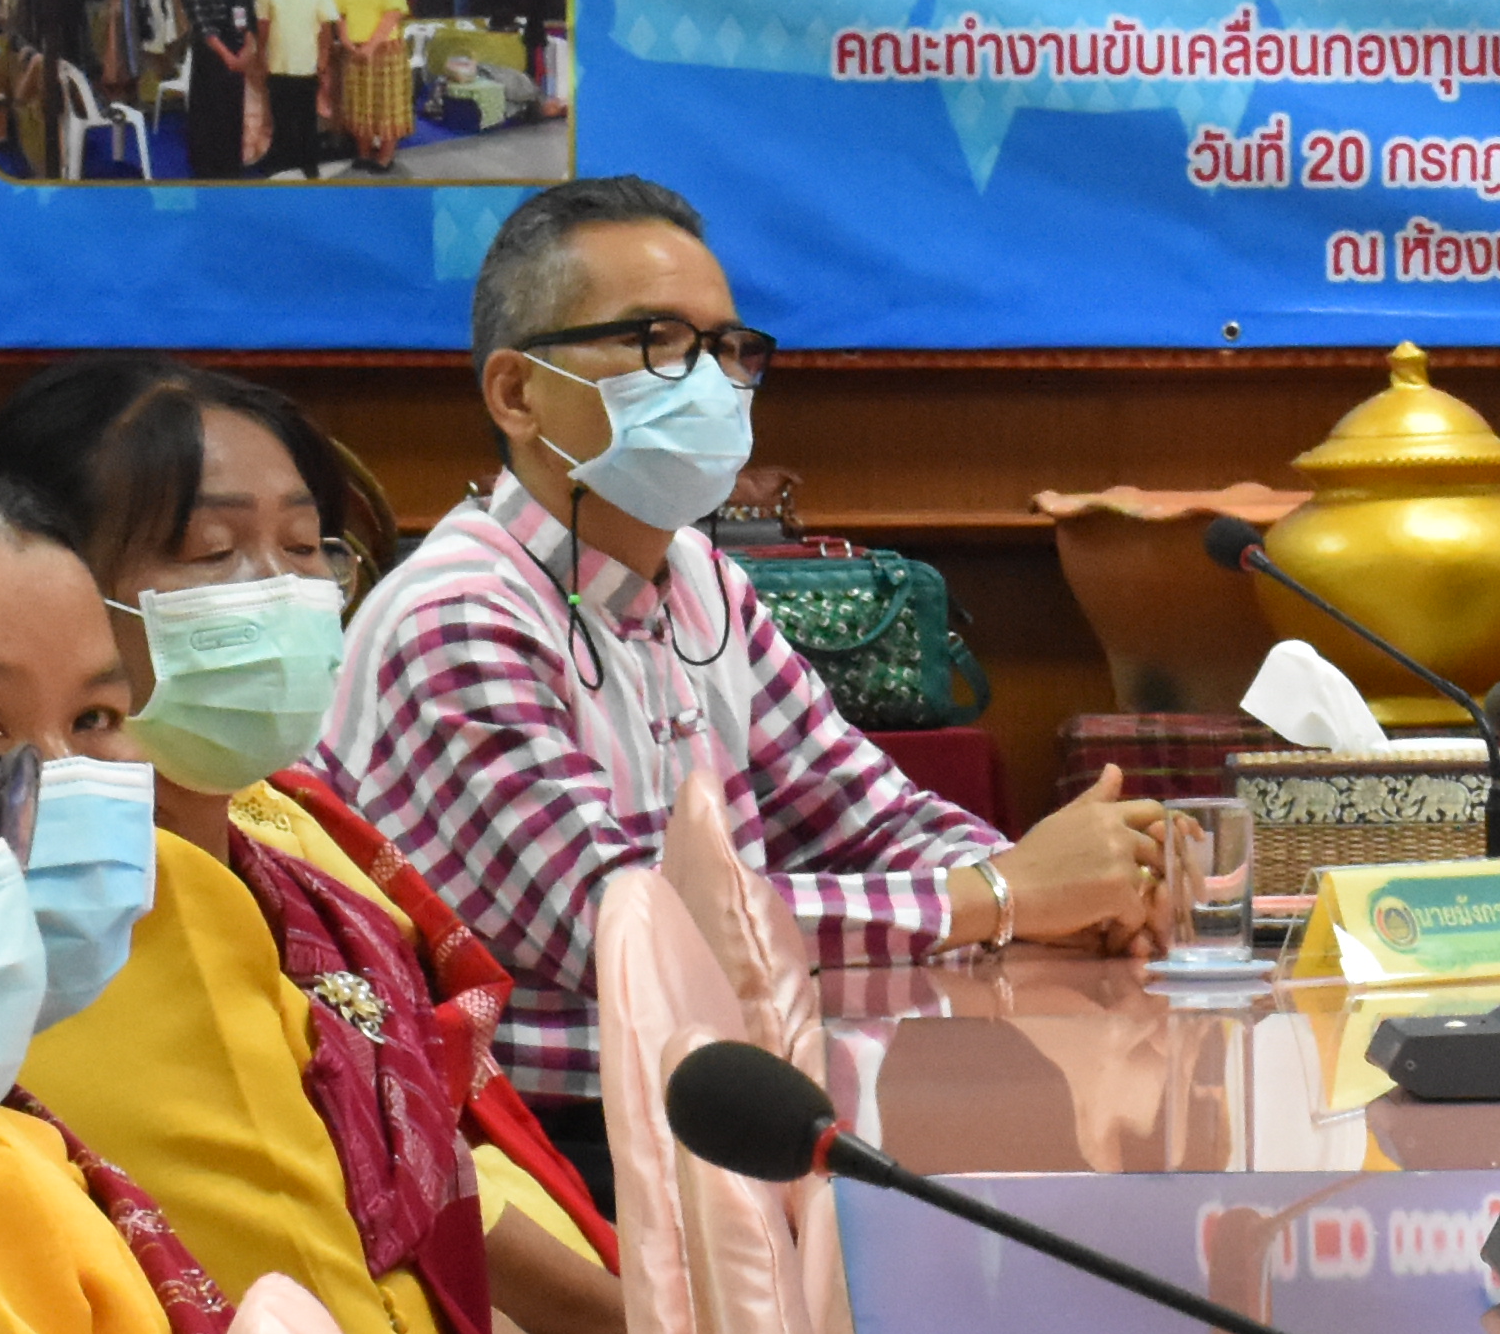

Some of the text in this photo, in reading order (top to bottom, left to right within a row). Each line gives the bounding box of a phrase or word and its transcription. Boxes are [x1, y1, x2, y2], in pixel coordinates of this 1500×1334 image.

[1192, 113, 1286, 185] วันที่
[1309, 135, 1367, 185] 20
[1332, 235, 1381, 278] ณ
